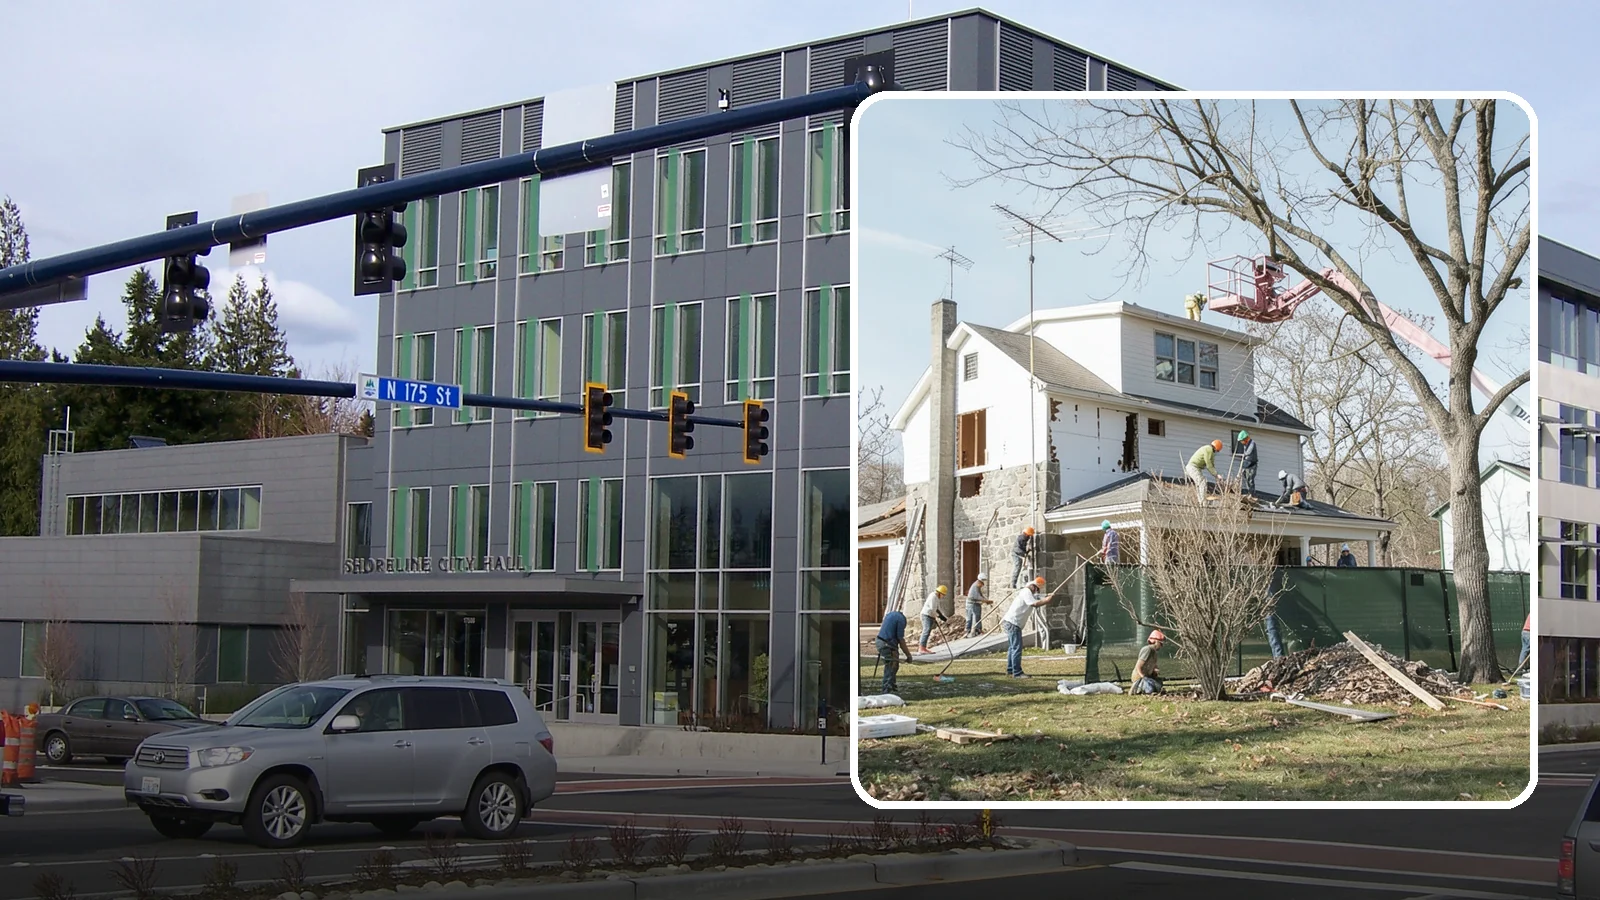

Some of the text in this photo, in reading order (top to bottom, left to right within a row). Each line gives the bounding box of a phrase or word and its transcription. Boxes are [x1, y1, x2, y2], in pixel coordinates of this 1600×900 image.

[387, 380, 451, 406] N 175 St
[344, 555, 526, 574] SHORELINE CITY HALL
